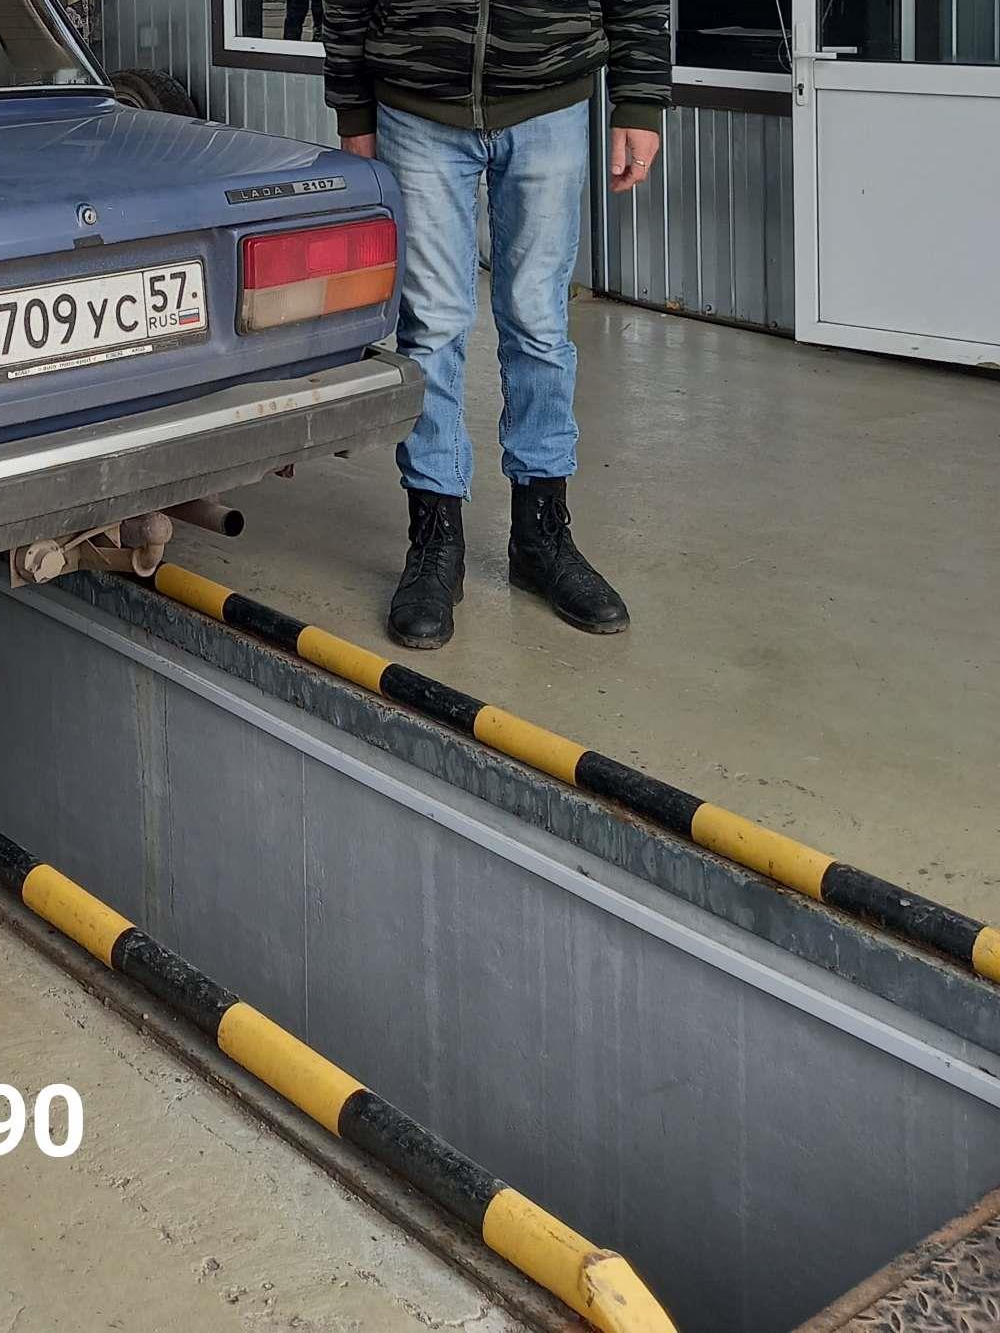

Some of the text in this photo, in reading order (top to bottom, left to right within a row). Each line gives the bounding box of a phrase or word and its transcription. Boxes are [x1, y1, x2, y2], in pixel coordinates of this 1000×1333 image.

[240, 179, 334, 199] LADA 2107
[149, 271, 187, 313] 57
[149, 316, 178, 329] RUS
